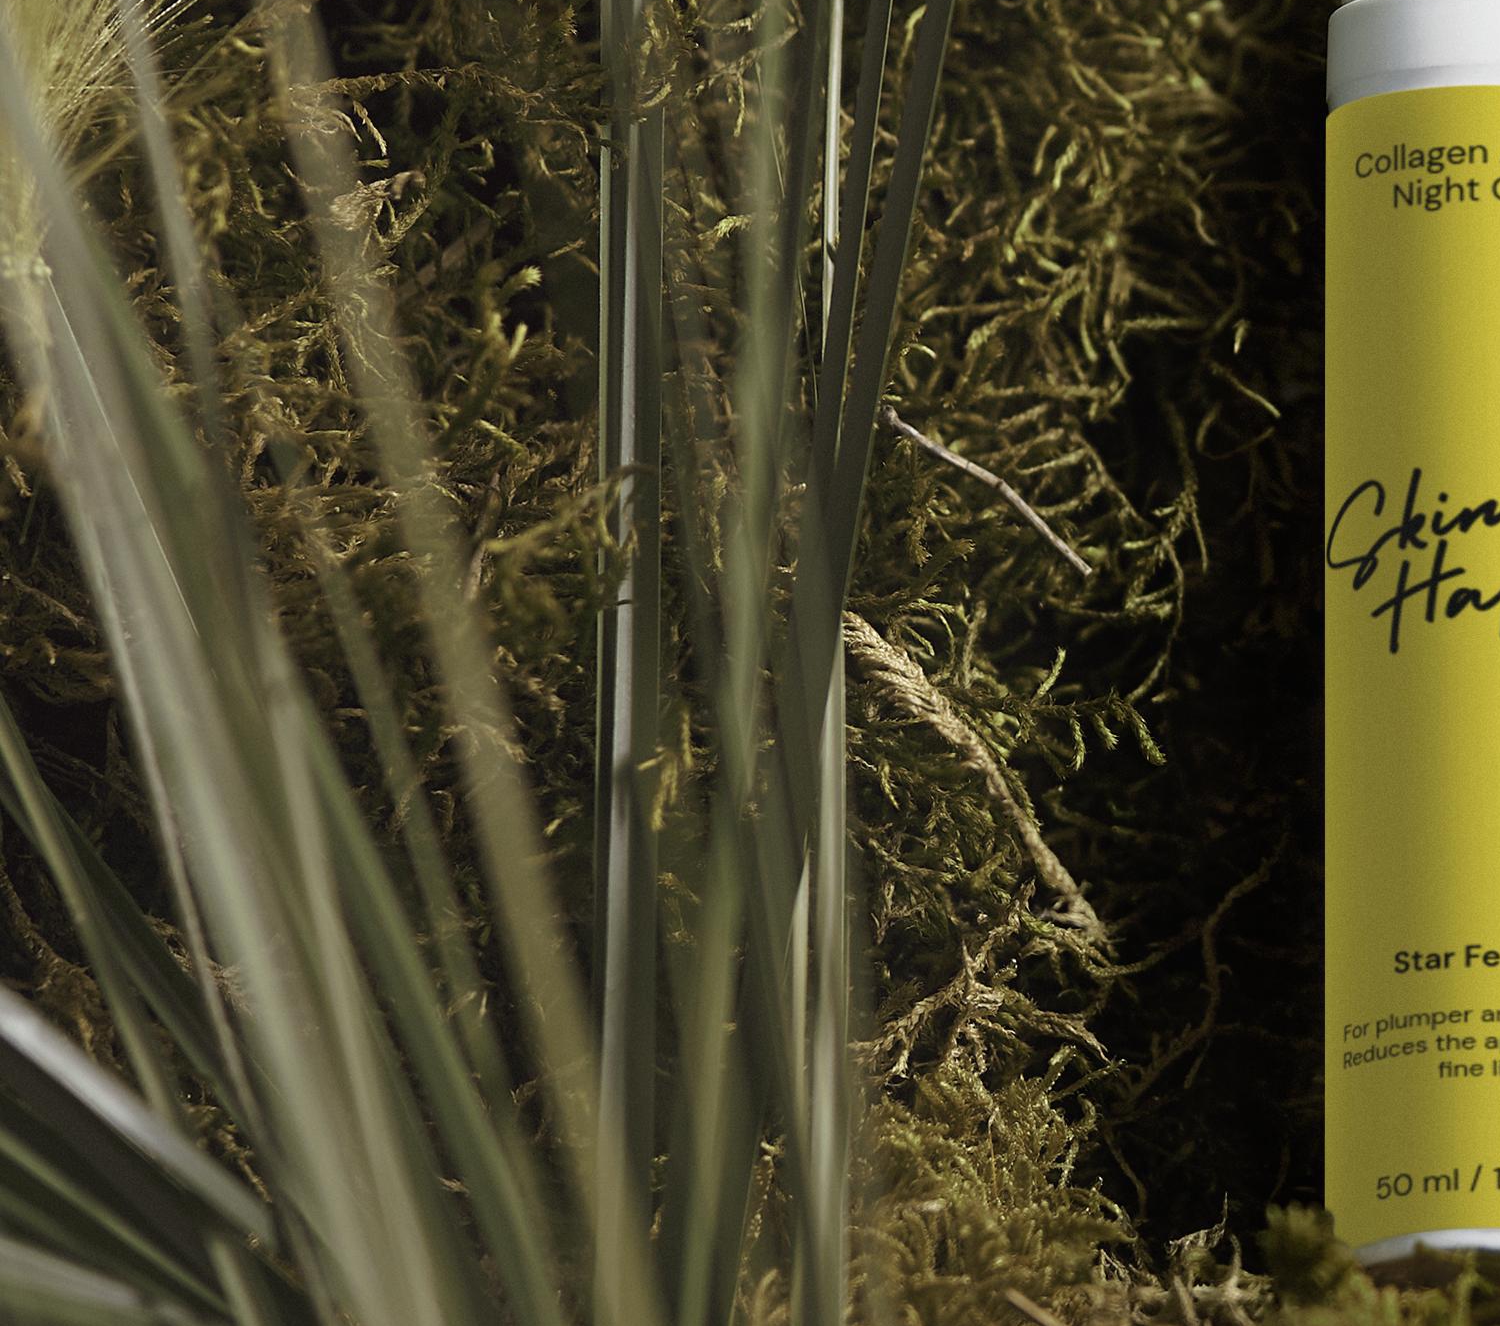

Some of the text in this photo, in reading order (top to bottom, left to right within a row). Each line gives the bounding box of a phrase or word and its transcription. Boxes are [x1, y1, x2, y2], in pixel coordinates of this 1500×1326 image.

[1355, 143, 1488, 178] Collagen
[1393, 177, 1480, 211] Night
[1394, 949, 1455, 974] Star
[1343, 1023, 1369, 1042] For
[1376, 1009, 1473, 1038] plumper
[1343, 1036, 1427, 1070] Reduces
[1436, 1034, 1477, 1052] the
[1439, 1060, 1484, 1078] fine
[1376, 1173, 1412, 1200] 50
[1423, 1168, 1459, 1193] ml
[1470, 1164, 1482, 1192] /
